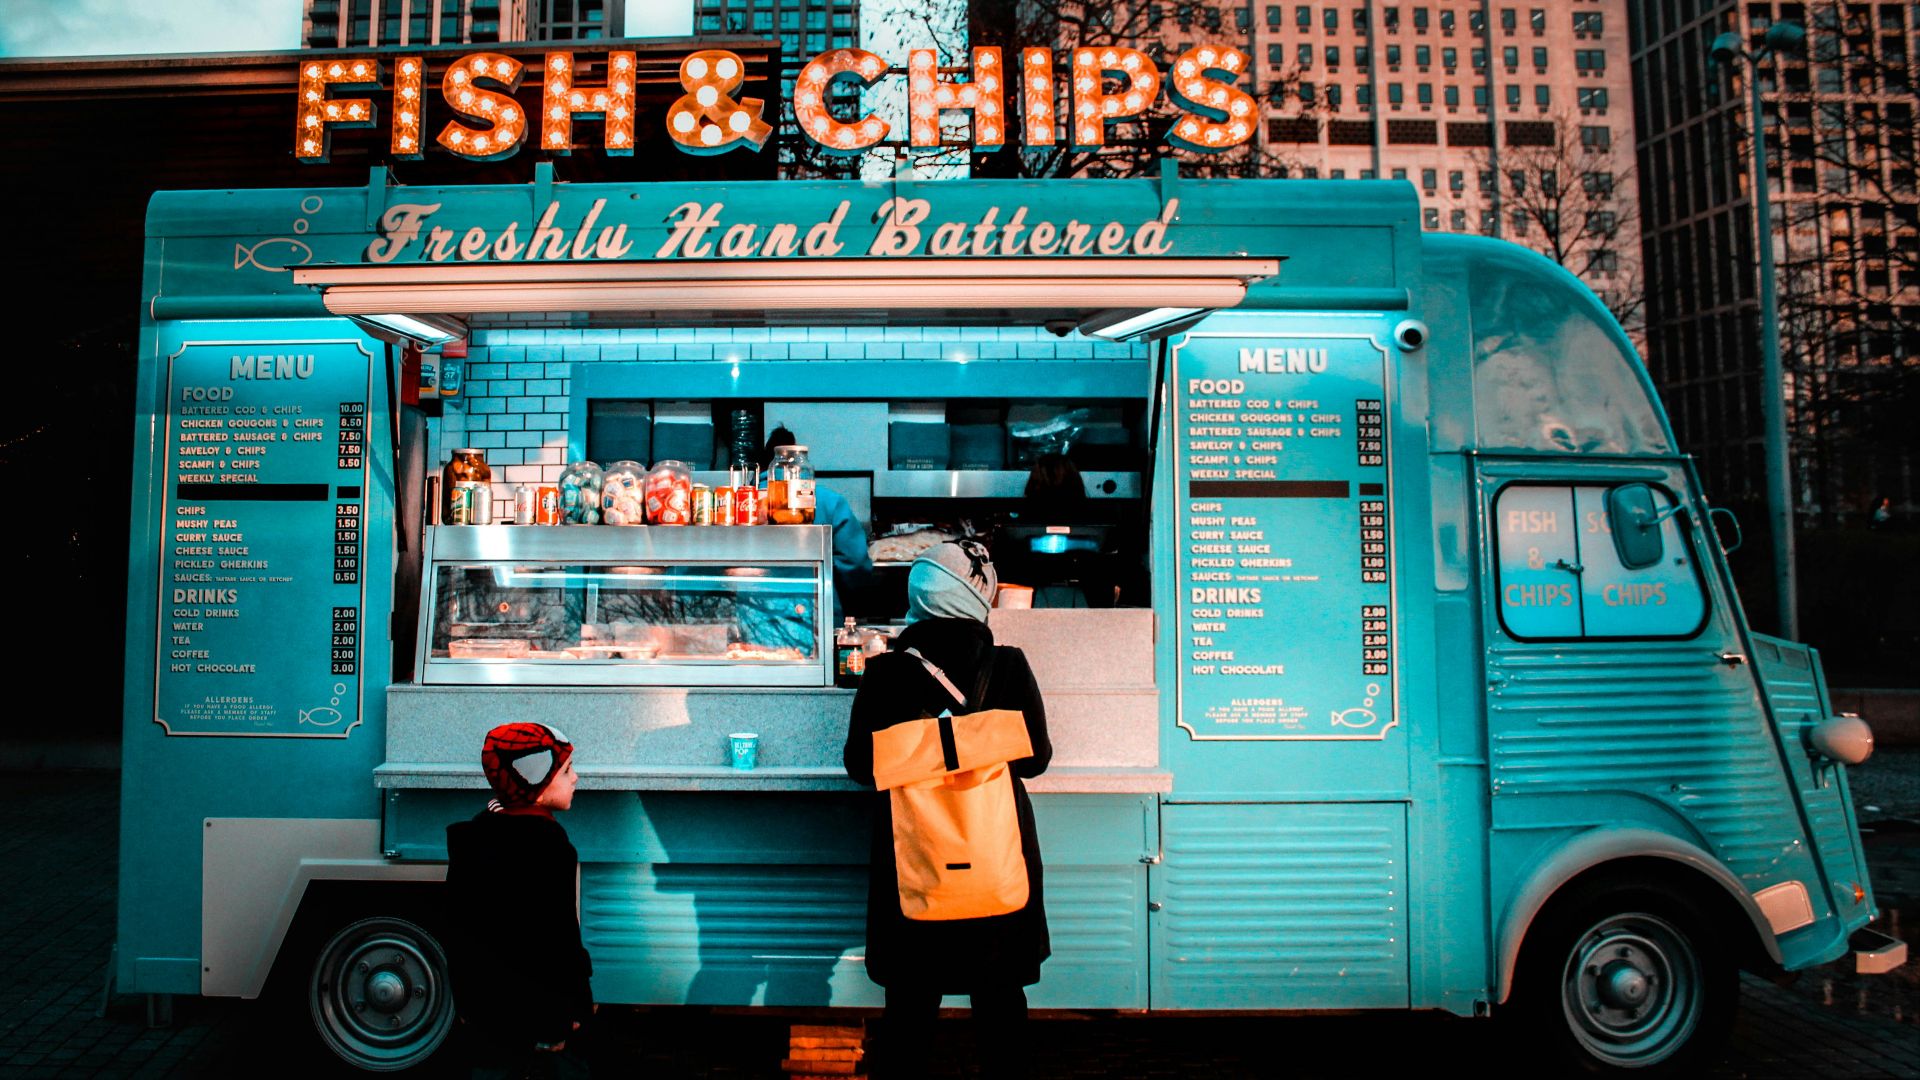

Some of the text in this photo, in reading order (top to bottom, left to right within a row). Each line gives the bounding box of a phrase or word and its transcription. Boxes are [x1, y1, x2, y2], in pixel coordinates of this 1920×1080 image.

[295, 46, 1259, 163] FISH & CHIPS
[653, 201, 845, 258] Hand
[866, 197, 1179, 256] Battered
[1240, 347, 1327, 372] MENU
[232, 355, 314, 378] MENU
[1190, 379, 1245, 394] FOOD
[183, 387, 233, 400] FOOD
[1190, 400, 1241, 408] BATTERED
[1247, 400, 1269, 408] COD
[1287, 400, 1318, 408] CHIPS
[182, 406, 229, 414] BATTERED
[340, 405, 362, 413] 10.00
[1190, 413, 1235, 422] CHICKEN
[1240, 414, 1292, 422] GOUGONS
[1311, 414, 1341, 422] CHIPS
[229, 419, 277, 427] GOUGONS
[341, 419, 361, 427] 8.50
[1190, 427, 1241, 436] BATTERED
[1247, 428, 1292, 436] SAUSAGE
[1310, 428, 1341, 436] CHIPS
[1360, 429, 1380, 437] 7.50
[181, 433, 228, 441] BATTERED
[234, 433, 275, 441] SAUSAGE
[294, 432, 322, 440] CHIPS
[1191, 441, 1233, 450] SAVELOY
[1252, 441, 1283, 450] CHIPS
[1359, 442, 1380, 450] 7.50
[180, 447, 219, 455] SAVELOY
[238, 446, 266, 454] CHIPS
[340, 446, 360, 454] 7.50
[339, 459, 359, 467] 8.50
[1190, 455, 1228, 464] SCAMPI
[1246, 456, 1277, 464] CHIPS
[220, 460, 225, 468] &
[232, 460, 260, 468] CHIPS
[179, 474, 258, 482] WEEKLY SPECIAL
[1191, 470, 1276, 478] WEEKLY SPECIAL
[338, 506, 358, 514] 3.50
[1191, 503, 1222, 511] CHIPS
[1362, 503, 1383, 511] 3.50
[177, 520, 237, 528] MUSHY PEAS
[1191, 517, 1256, 525] MUSHY PEAS
[1363, 517, 1382, 525] 1.50
[1507, 511, 1557, 533] FISH
[338, 533, 356, 541] 1.50
[1192, 531, 1263, 539] CURRY SAUCE
[1364, 531, 1383, 539] 1.50
[1192, 544, 1270, 553] CHEESE SAUCE
[1192, 558, 1292, 567] PICKLED GHERKINS
[1528, 547, 1545, 570] &
[175, 560, 268, 568] PICKLED GHERKINS
[337, 560, 355, 568] 1.00
[335, 573, 355, 581] 0.50
[174, 589, 237, 603] DRINKS
[1192, 588, 1261, 603] DRINKS
[1504, 584, 1572, 607] CHIPS
[1603, 583, 1667, 606] CHIPS
[174, 609, 239, 617] COLD DRINKS
[1193, 609, 1264, 617] COLD DRINKS
[1193, 622, 1226, 631] WATER
[173, 636, 190, 644] TEA
[1193, 637, 1213, 646] TEA
[172, 650, 209, 658] COFFEE
[1193, 651, 1234, 660] COFFEE
[198, 664, 255, 672] CHOCOLATE
[333, 664, 353, 672] 3.00
[1193, 665, 1284, 674] HOT CHOCOLATE
